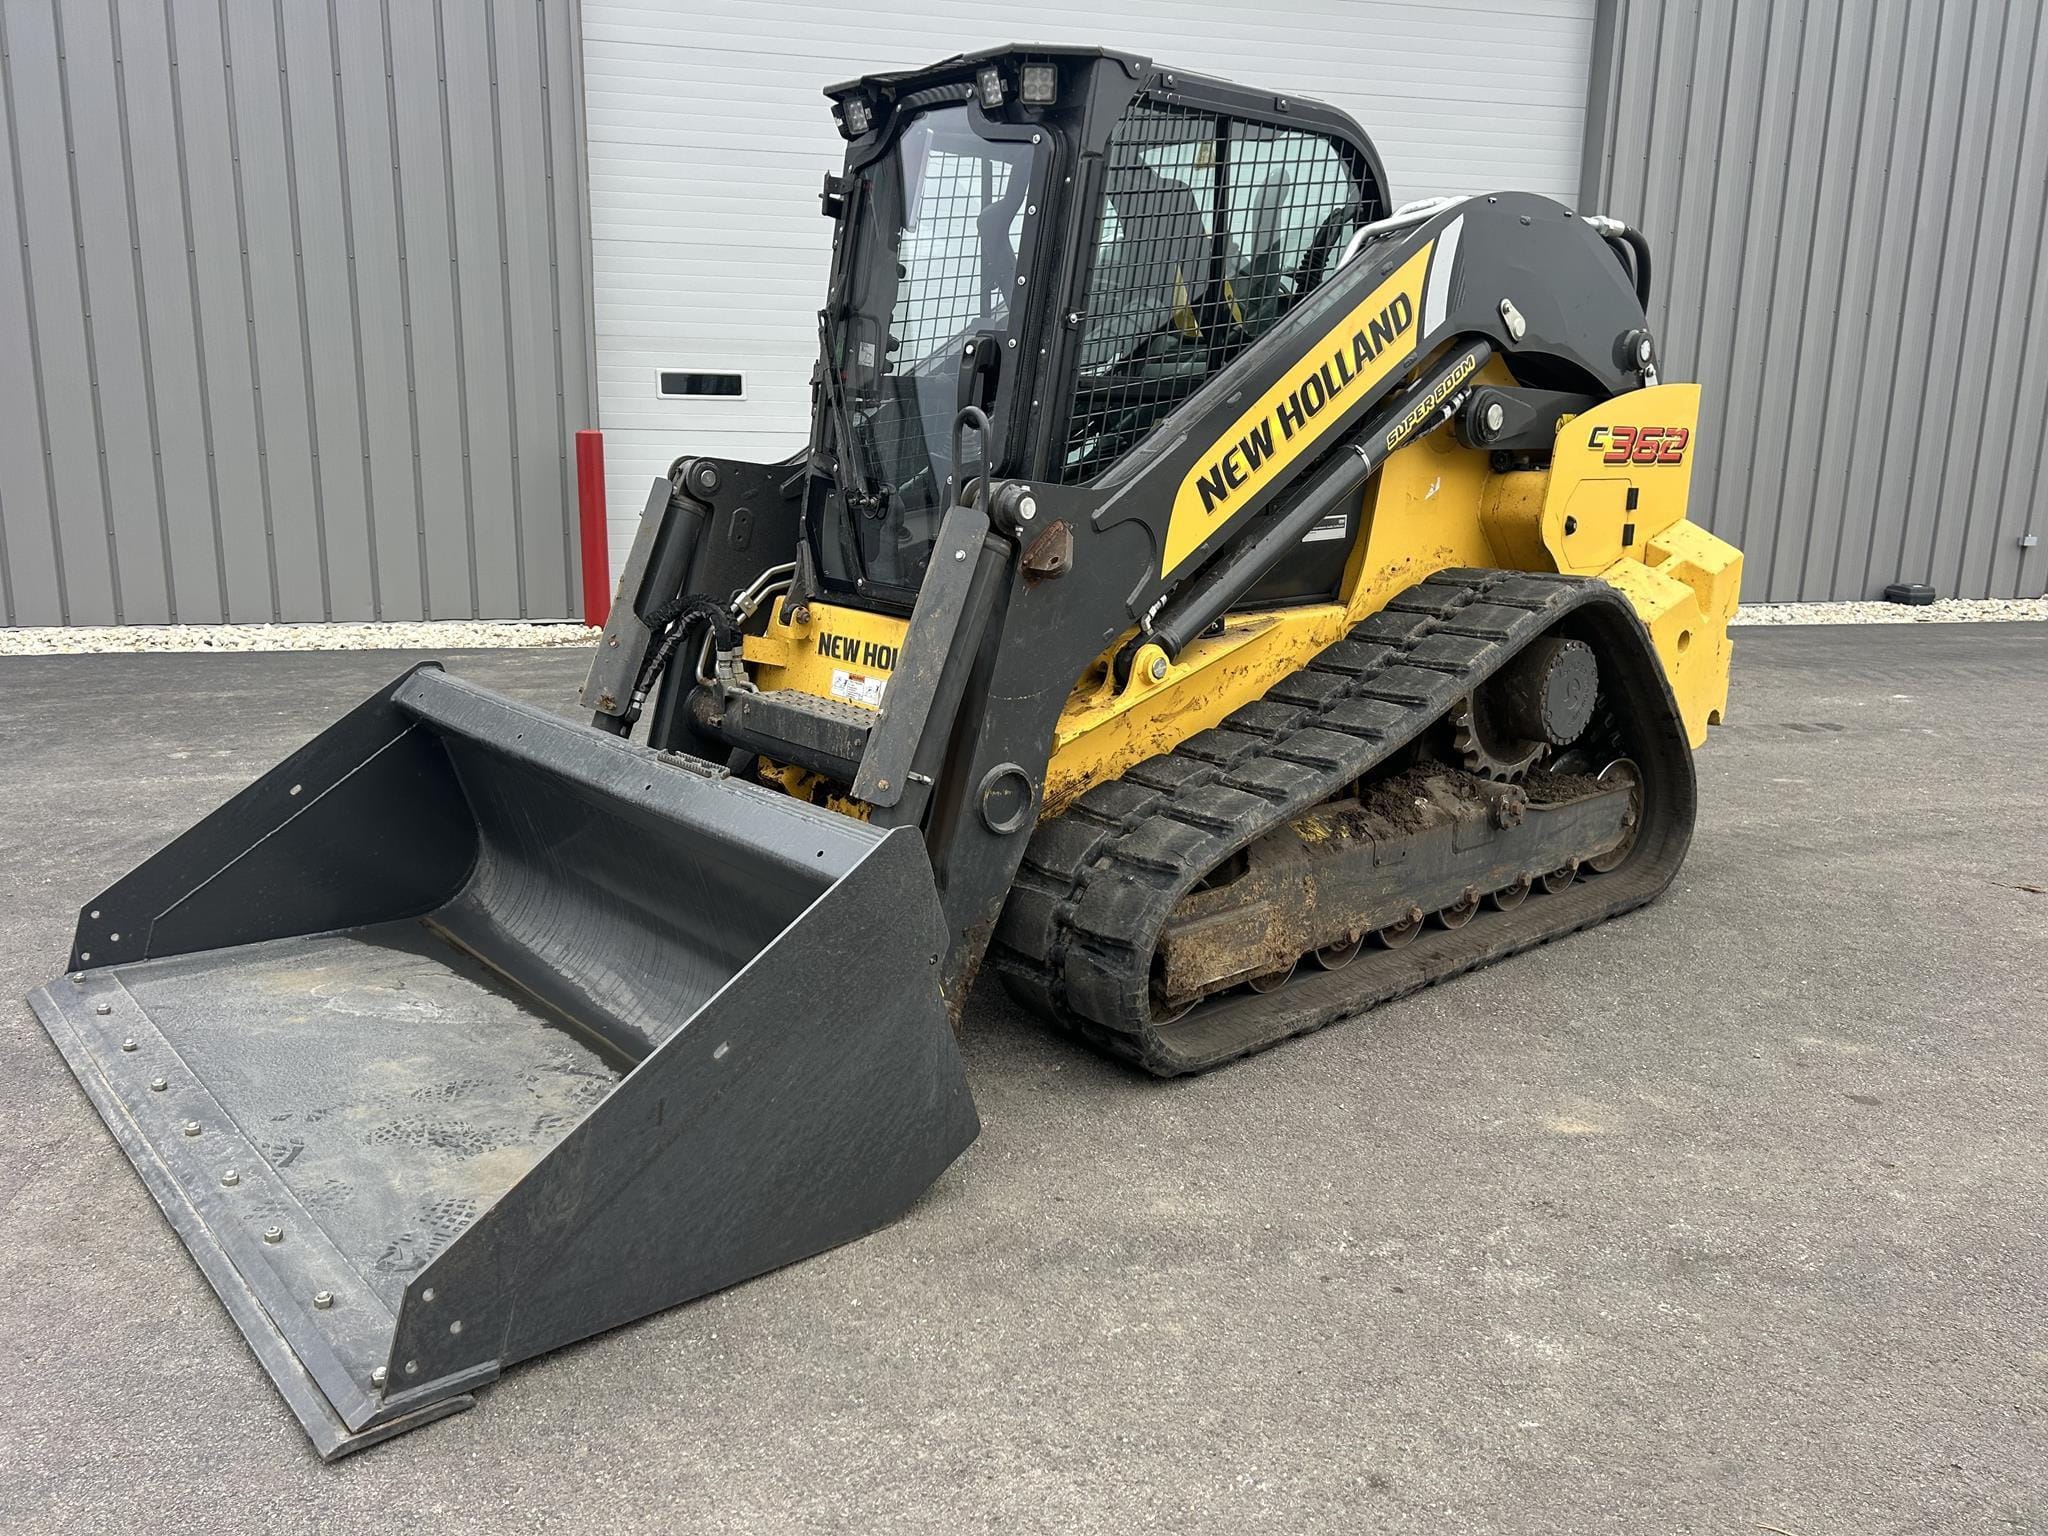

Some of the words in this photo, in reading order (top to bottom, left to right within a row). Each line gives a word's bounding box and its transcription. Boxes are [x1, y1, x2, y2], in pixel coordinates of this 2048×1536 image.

[1196, 417, 1277, 514] NEW
[1276, 292, 1414, 440] HOLLAND
[1387, 395, 1435, 450] SUPER
[1434, 354, 1476, 404] BOOM
[818, 632, 861, 663] NEW
